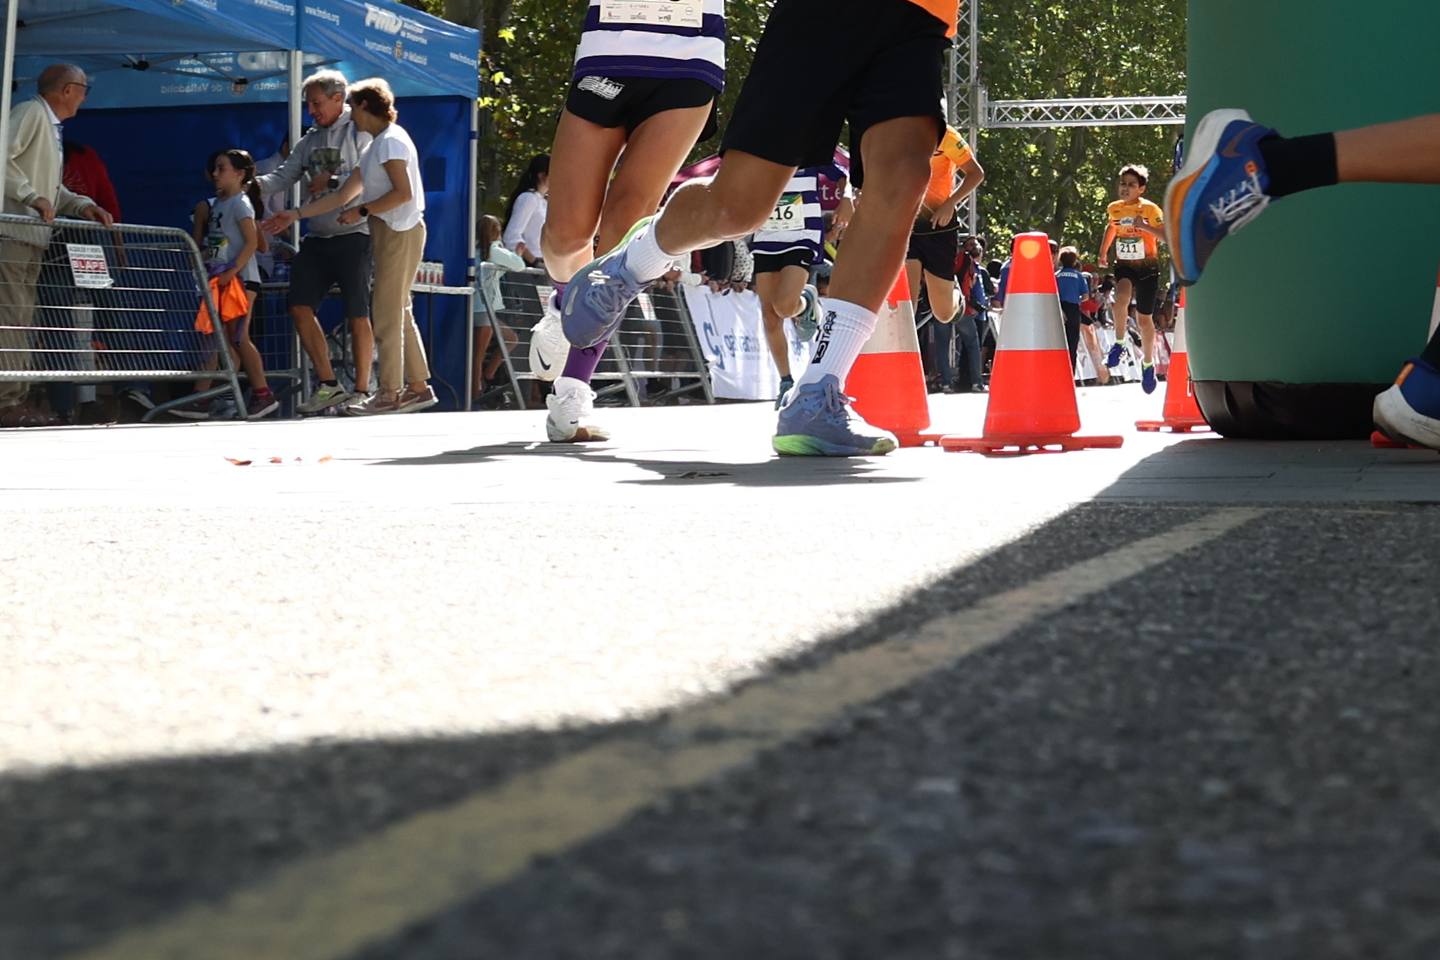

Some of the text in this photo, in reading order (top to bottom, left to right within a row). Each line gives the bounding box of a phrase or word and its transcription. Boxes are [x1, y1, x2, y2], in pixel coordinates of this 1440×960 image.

[769, 206, 793, 221] 16
[1119, 242, 1137, 254] 211
[72, 259, 107, 272] BLAPE
